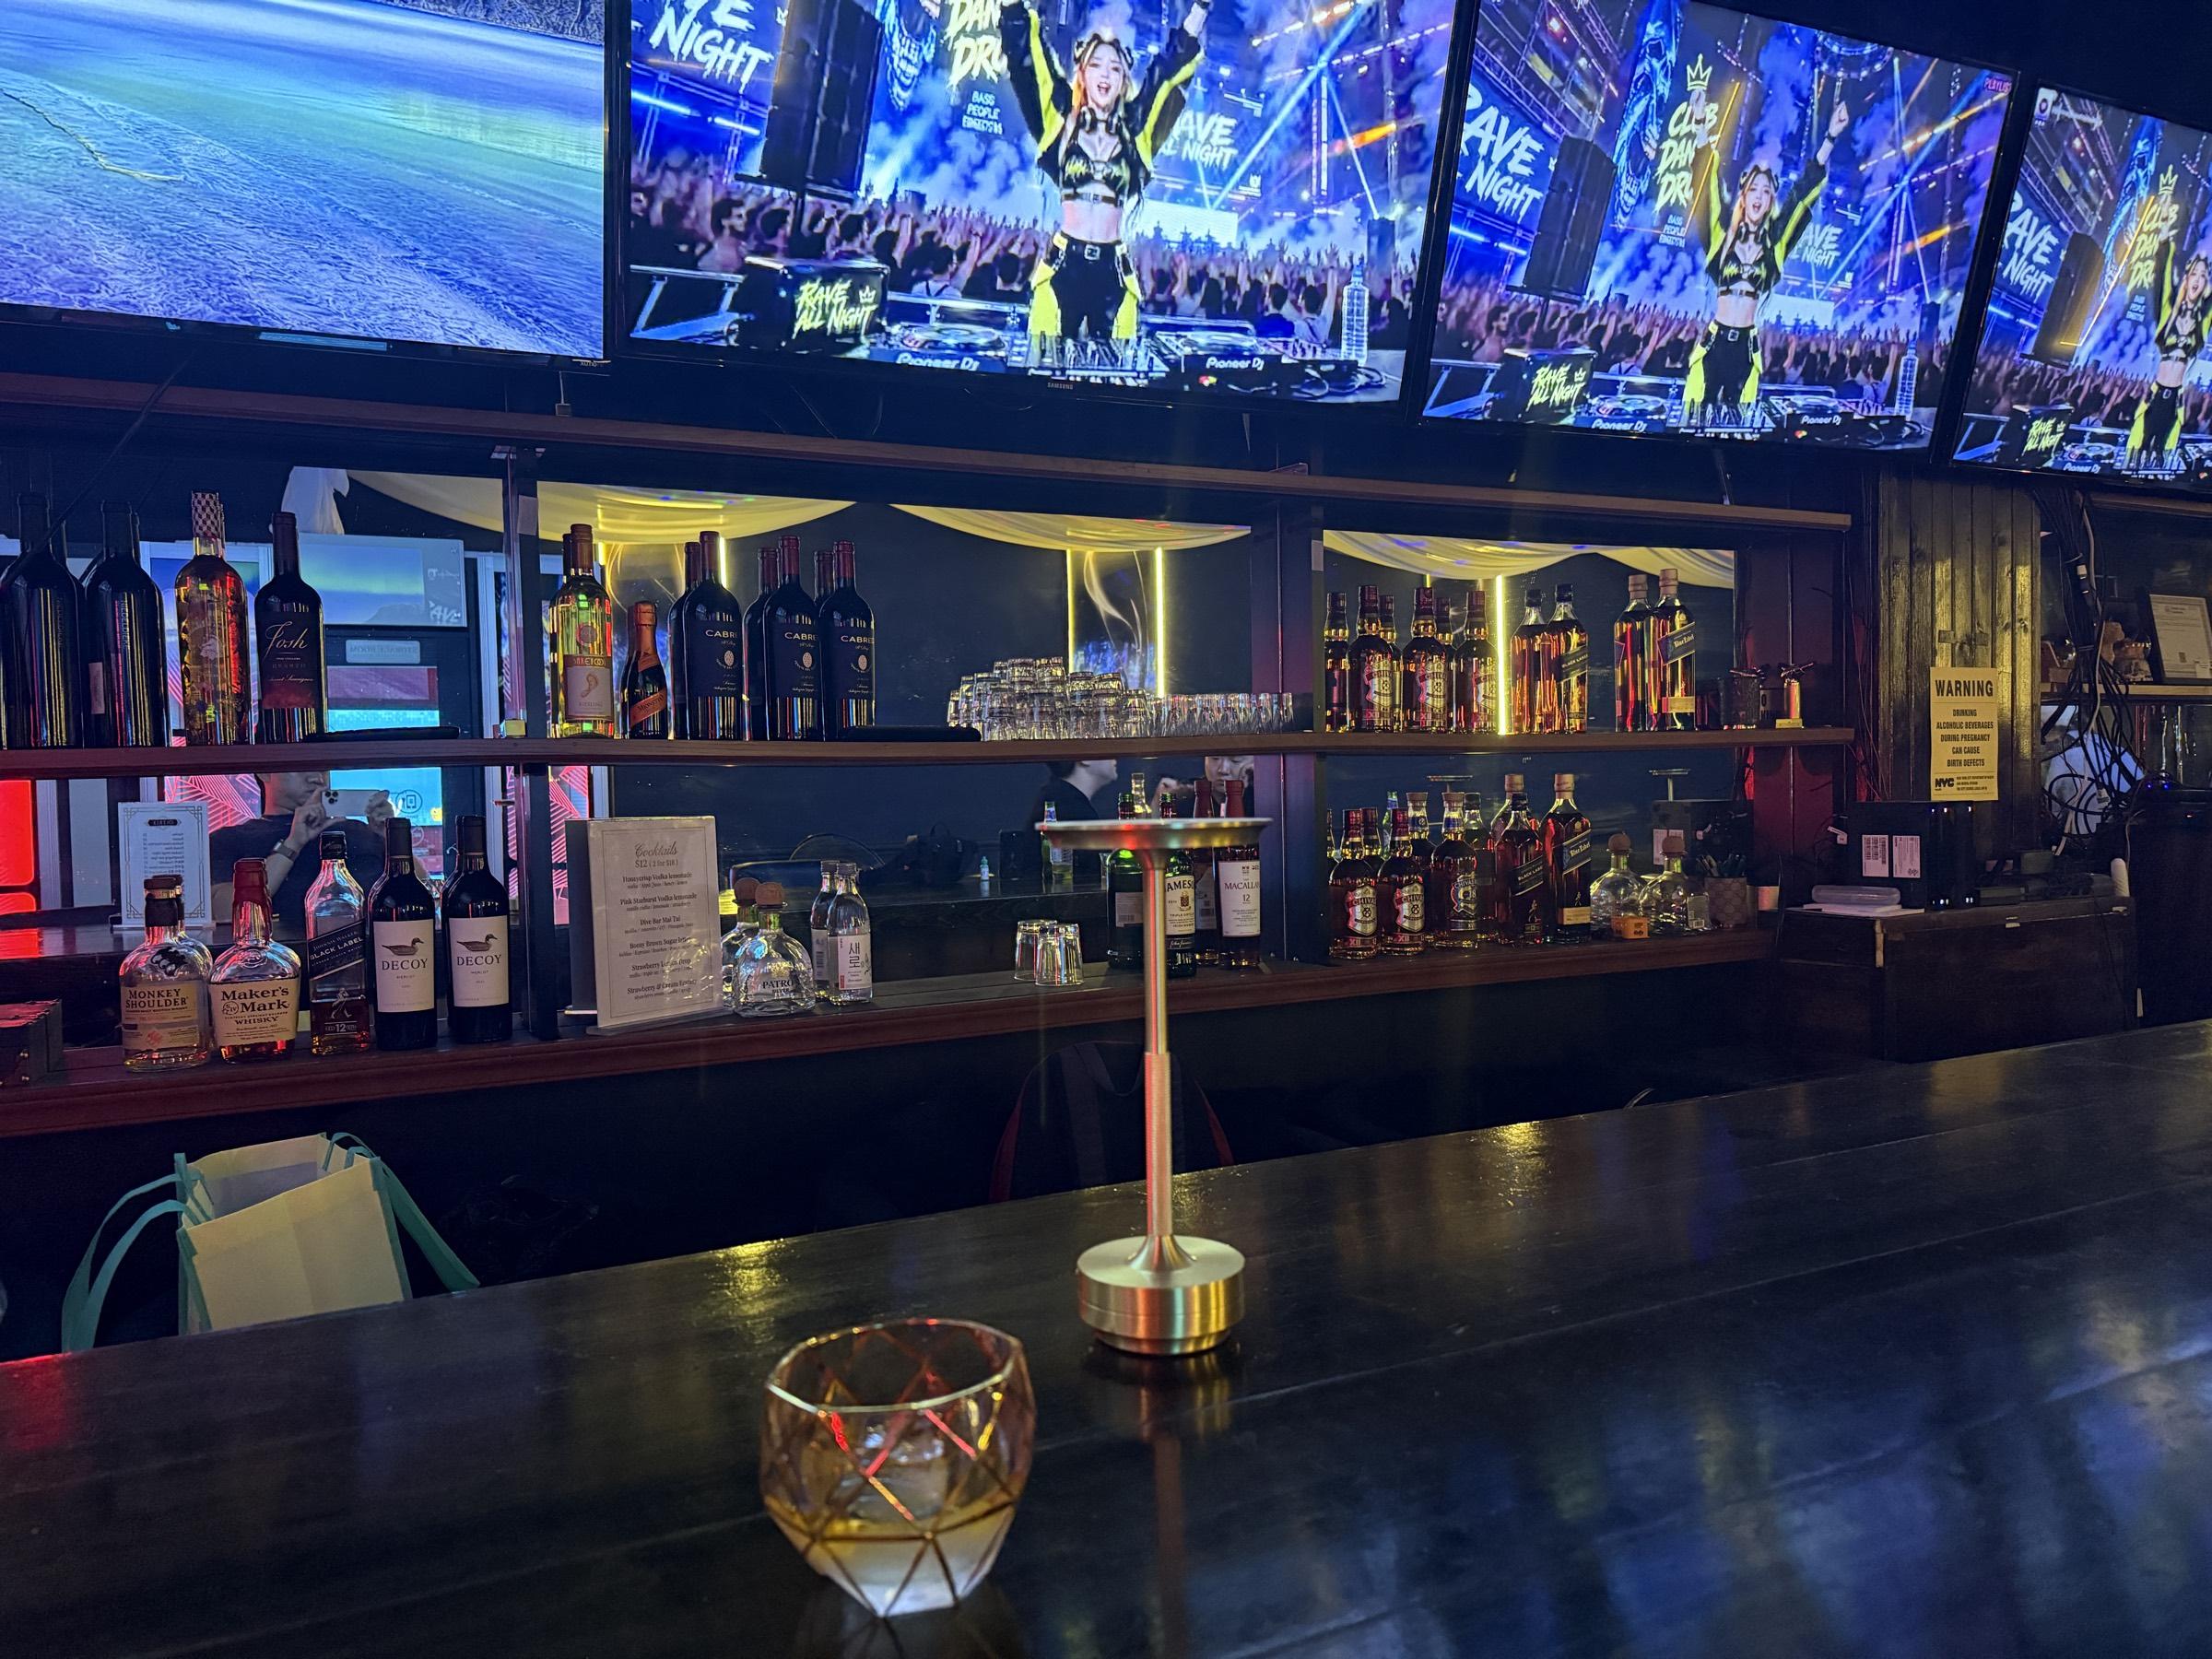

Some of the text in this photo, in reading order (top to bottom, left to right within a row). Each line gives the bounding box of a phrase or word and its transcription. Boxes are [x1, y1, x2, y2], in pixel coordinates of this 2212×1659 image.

[649, 6, 774, 95] NIGHT
[971, 90, 995, 106] BASS
[1171, 110, 1238, 145] AVE
[1181, 140, 1239, 171] NIGHT
[1465, 158, 1544, 224] NIGHT
[1795, 221, 1843, 250] AVE
[1801, 245, 1841, 269] NIGHT
[2003, 251, 2054, 304] NIGHT
[796, 279, 851, 318] RAVE
[792, 300, 878, 343] ALL NIGHT
[896, 352, 960, 371] Pioneer
[1206, 357, 1248, 370] Pioneer
[1531, 362, 1571, 395] RAVE
[1525, 381, 1586, 413] ALL NIGHT
[1591, 418, 1632, 431] Pioneer
[1801, 415, 1831, 425] Pioneer
[2030, 418, 2055, 441] RAVE
[2022, 430, 2065, 458] ALL NIGHT
[2063, 464, 2091, 473] Pioneer
[264, 621, 310, 659] Josh
[705, 629, 737, 639] CABR
[1674, 638, 1684, 648] Blue
[1936, 680, 1994, 697] WARNING
[1963, 759, 1985, 767] DEFECTS
[1936, 778, 1954, 787] NYC
[634, 841, 678, 858] Cocktails
[1570, 847, 1580, 857] Blue
[635, 860, 647, 868] $12
[1166, 879, 1194, 892] AMES
[1243, 894, 1250, 902] 12
[1353, 898, 1375, 906] CHIVA
[310, 935, 364, 960] BLACK LABEL
[664, 937, 677, 946] Sugar
[382, 959, 428, 971] DECOY
[457, 955, 501, 966] DECOY
[631, 962, 660, 971] Strawberry
[678, 958, 691, 966] Drop
[129, 989, 181, 999] MONKEY
[221, 986, 288, 1001] Maker's
[628, 985, 655, 994] Strawberry
[125, 997, 187, 1008] SHOULDER
[241, 999, 289, 1013] Mark
[235, 1016, 278, 1025] WHISKY
[335, 1023, 347, 1032] 12
